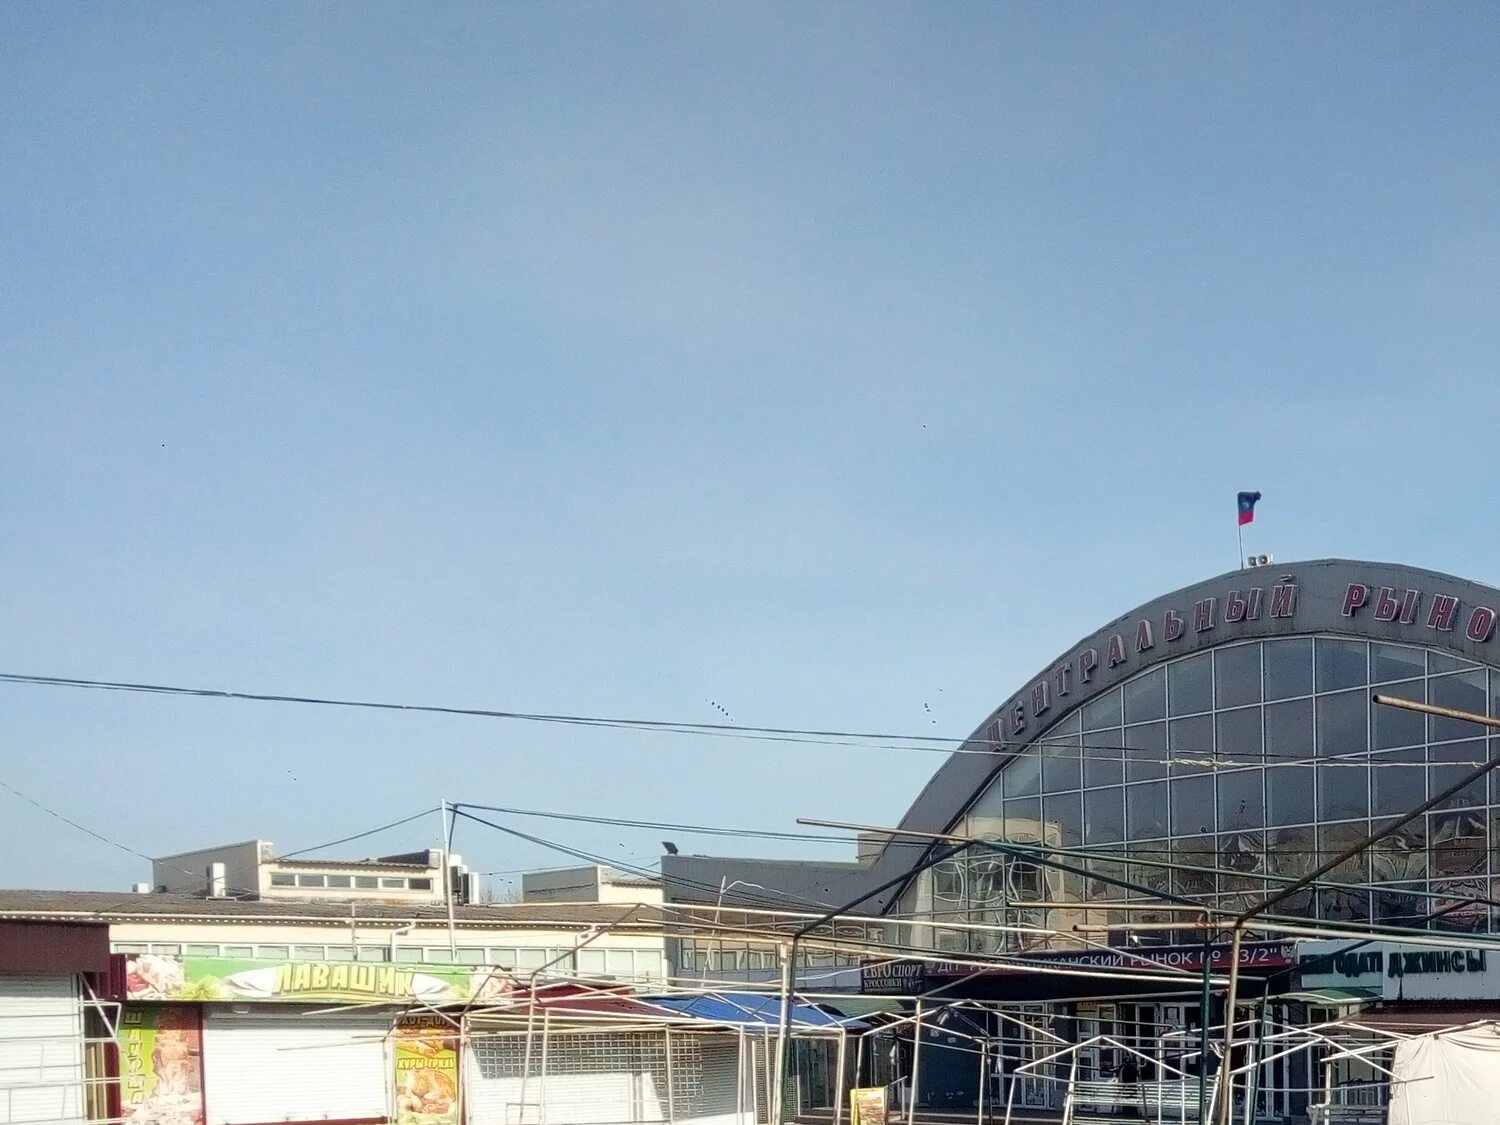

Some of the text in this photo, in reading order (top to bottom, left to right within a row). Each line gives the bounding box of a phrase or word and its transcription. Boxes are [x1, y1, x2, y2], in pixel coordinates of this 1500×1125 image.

[987, 574, 1298, 752] ЦЕНТРАЛЬНЫЙ
[272, 962, 415, 997] ЛАВАШИК
[1388, 950, 1487, 977] ДЖИНСЫ
